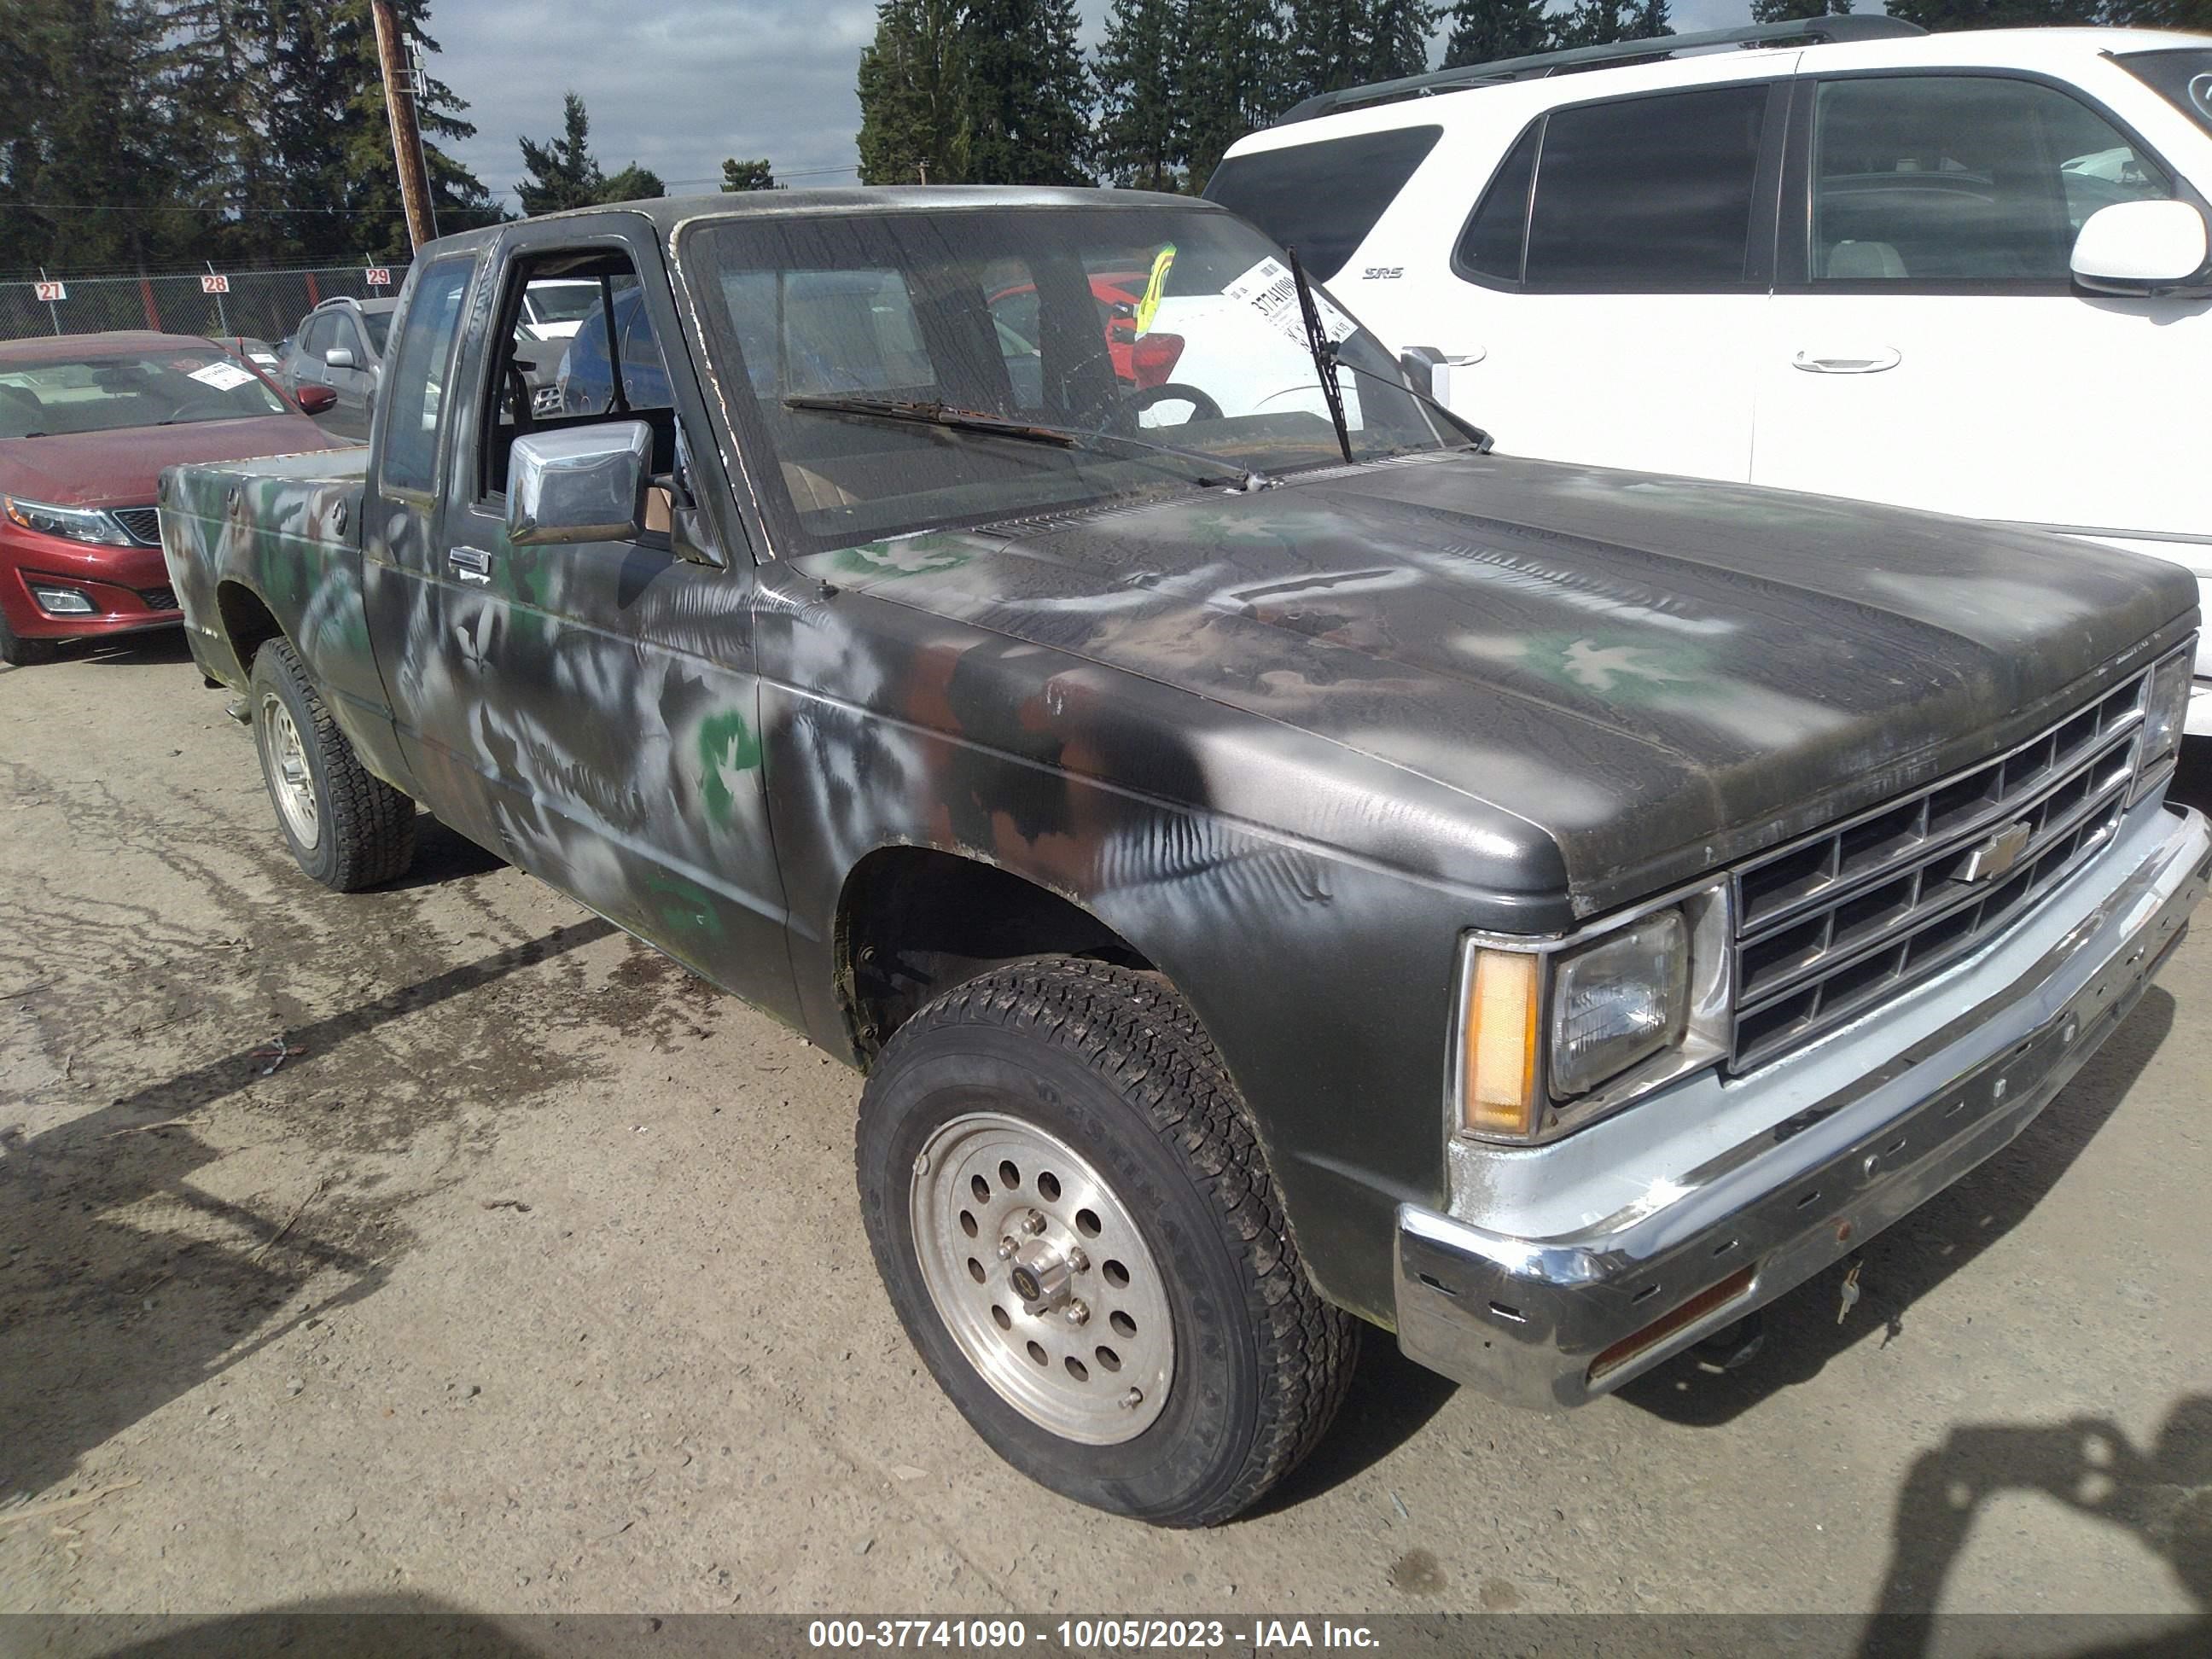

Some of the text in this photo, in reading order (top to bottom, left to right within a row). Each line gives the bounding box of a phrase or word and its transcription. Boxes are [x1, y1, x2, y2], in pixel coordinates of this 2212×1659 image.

[204, 276, 226, 292] 28
[368, 270, 388, 283] 29
[40, 283, 60, 299] 27
